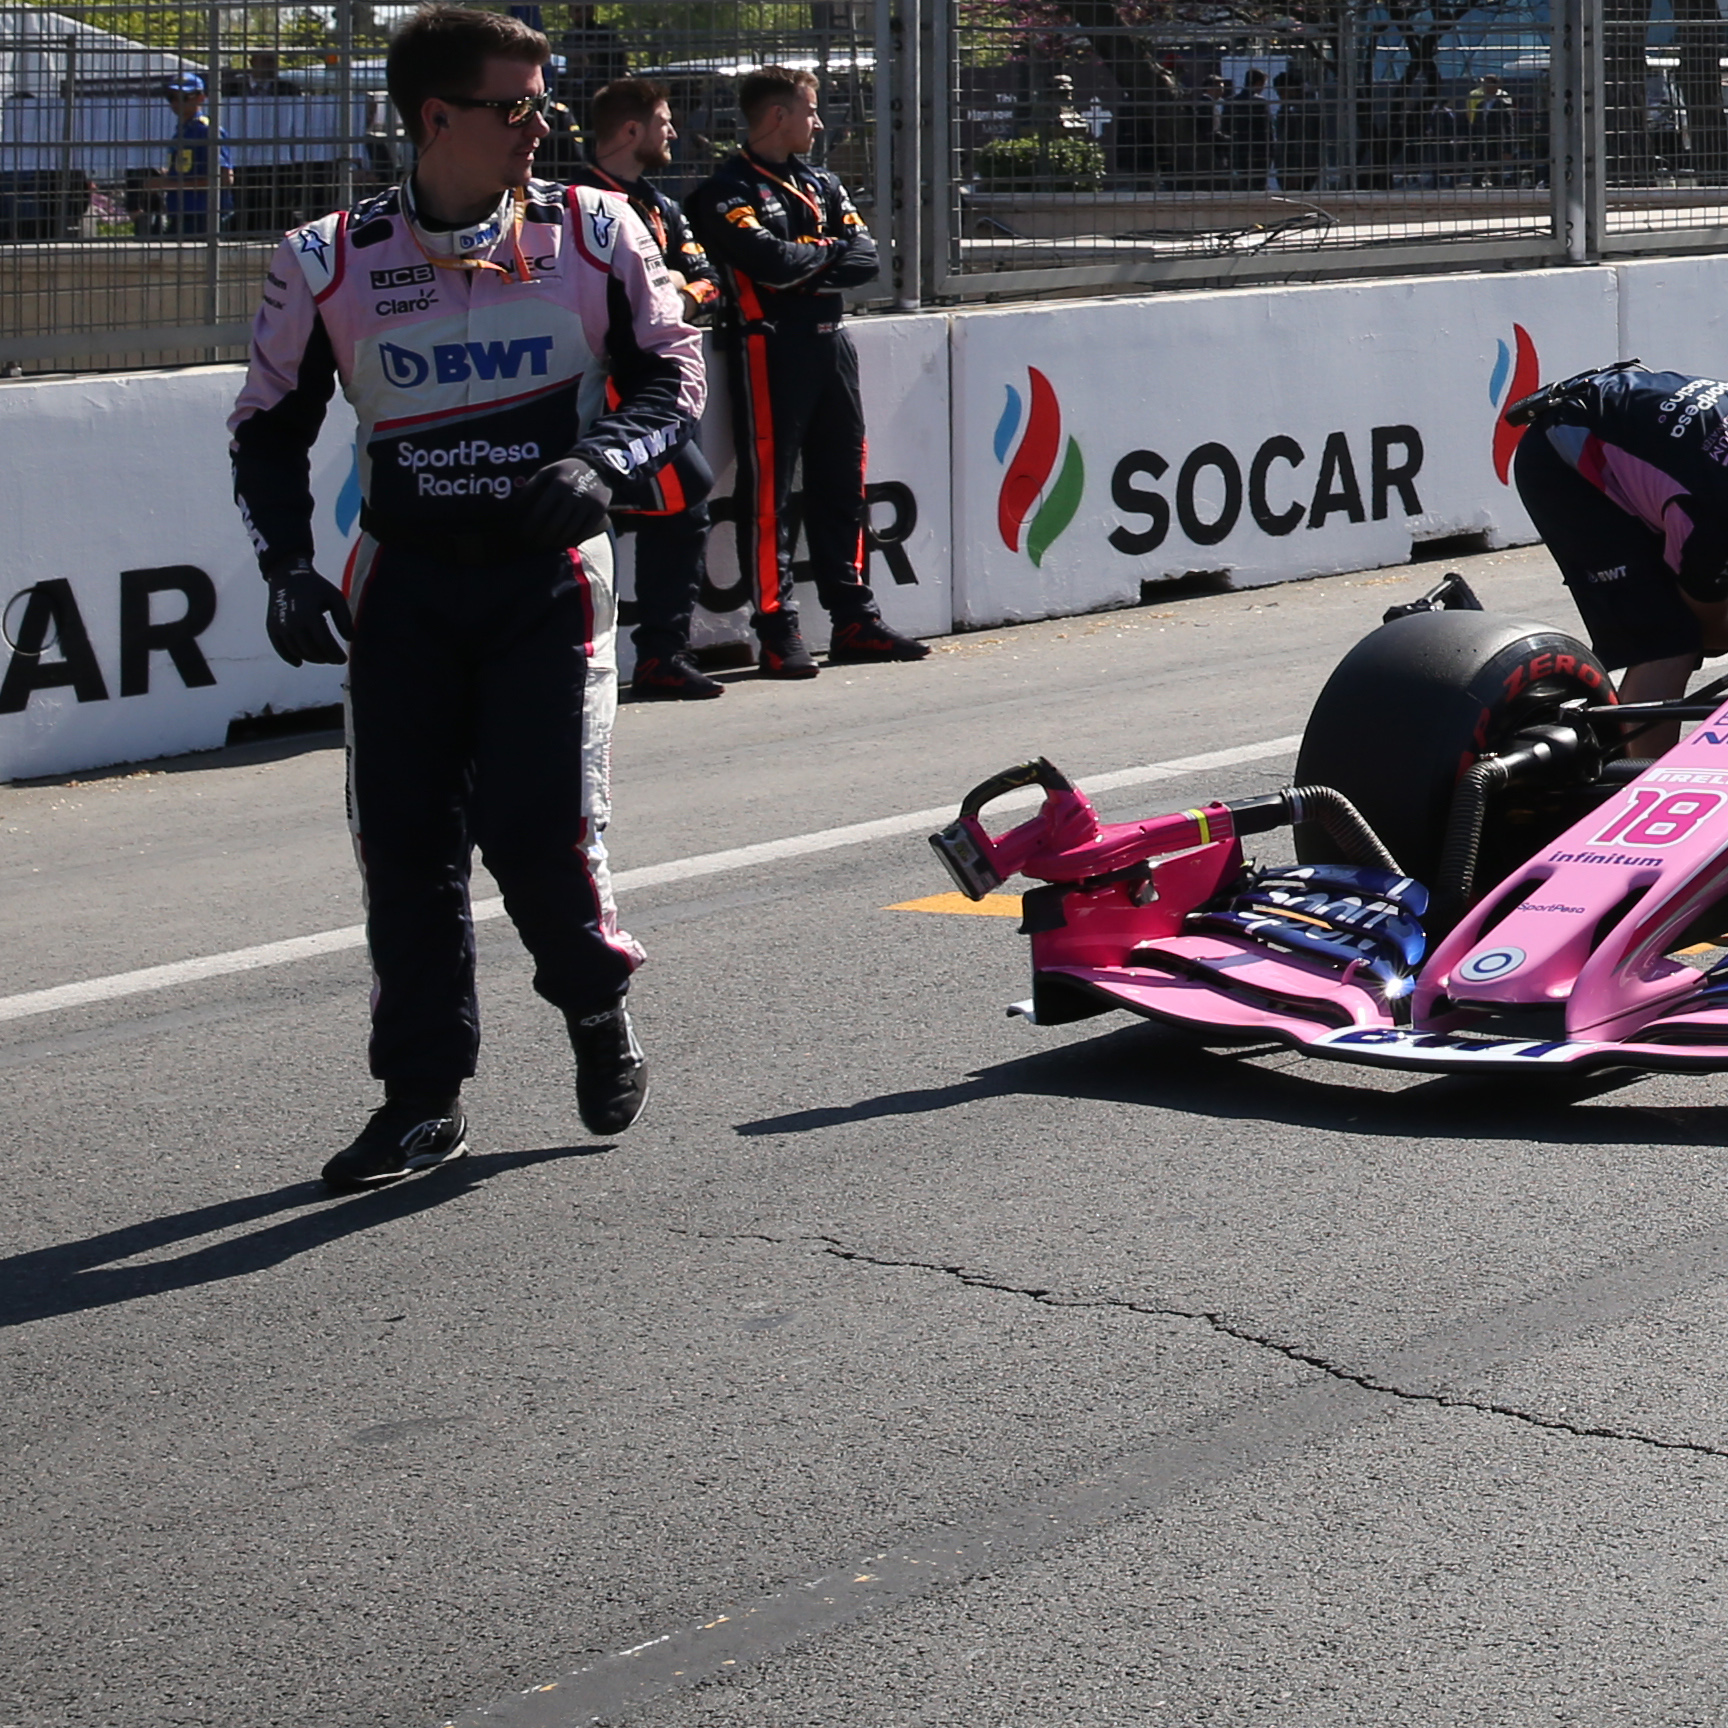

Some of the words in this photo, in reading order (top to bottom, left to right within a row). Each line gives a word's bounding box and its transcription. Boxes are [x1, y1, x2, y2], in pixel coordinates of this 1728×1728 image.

[372, 264, 434, 288] JCB
[376, 294, 430, 316] Claro
[433, 335, 554, 385] BWT
[398, 439, 540, 473] SportPesa
[628, 420, 682, 466] BWT
[418, 472, 512, 500] Racing
[1108, 424, 1424, 555] SOCAR
[1597, 565, 1627, 584] BWT
[276, 588, 286, 625] HyFlex
[1502, 652, 1604, 703] ZERO
[1585, 786, 1728, 850] 18
[1547, 850, 1664, 868] infinitum
[1516, 901, 1586, 915] SportPesa
